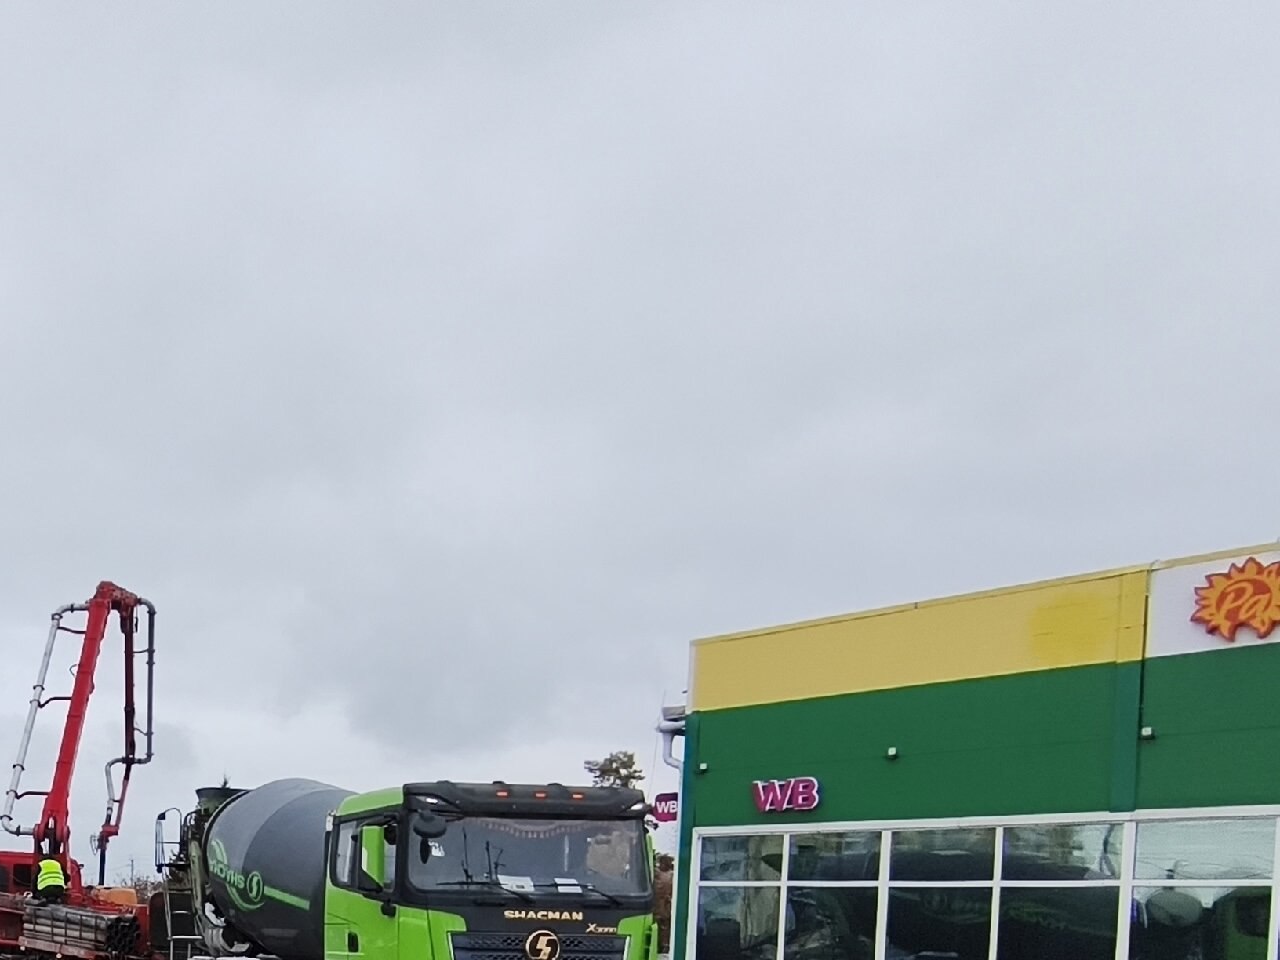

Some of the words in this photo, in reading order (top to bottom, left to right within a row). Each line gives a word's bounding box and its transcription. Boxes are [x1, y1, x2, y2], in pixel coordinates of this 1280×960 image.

[752, 776, 819, 812] WB
[655, 800, 678, 814] WB
[503, 910, 584, 920] SHACMAN
